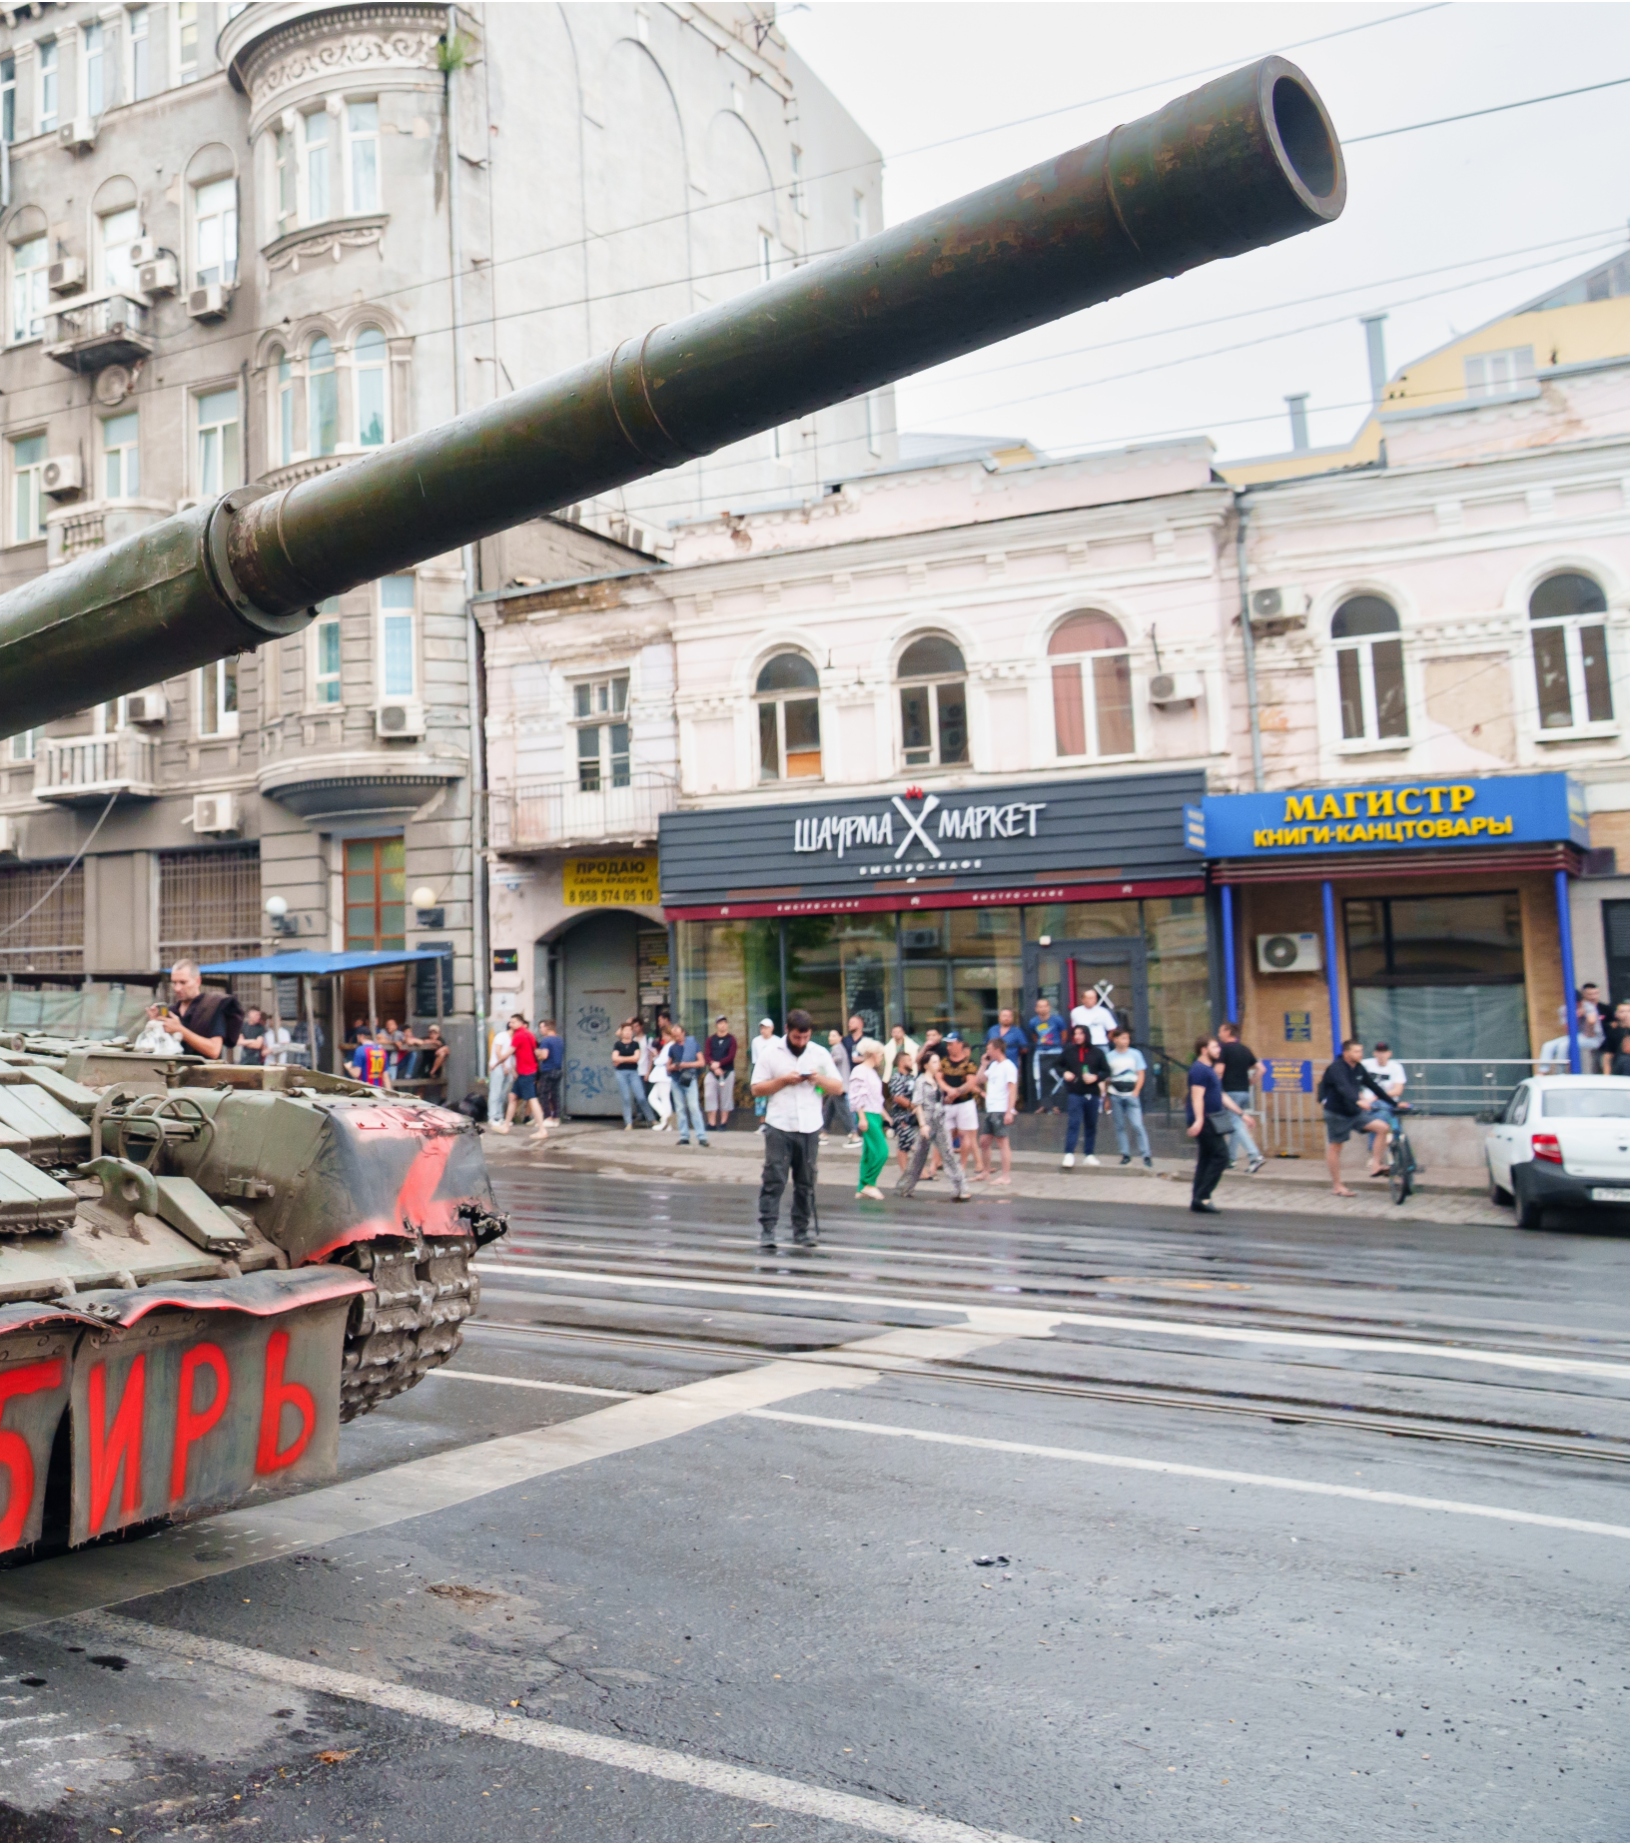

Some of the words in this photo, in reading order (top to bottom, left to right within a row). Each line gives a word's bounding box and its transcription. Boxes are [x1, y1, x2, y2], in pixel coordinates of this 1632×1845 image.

[1283, 785, 1476, 823] МАГИСТР
[793, 811, 894, 859] ШАУРМА
[938, 802, 1048, 840] МАРКЕТ
[1252, 815, 1514, 848] КНИГИ-КАНЦТОВАРЫ
[575, 861, 646, 875] ПРОДАЮ
[858, 858, 982, 876] БЫСТРО-КАФЕ
[573, 877, 604, 885] САЛОН
[569, 890, 576, 903] 8
[578, 890, 598, 903] 958
[601, 889, 620, 902] 574
[640, 889, 654, 902] 10
